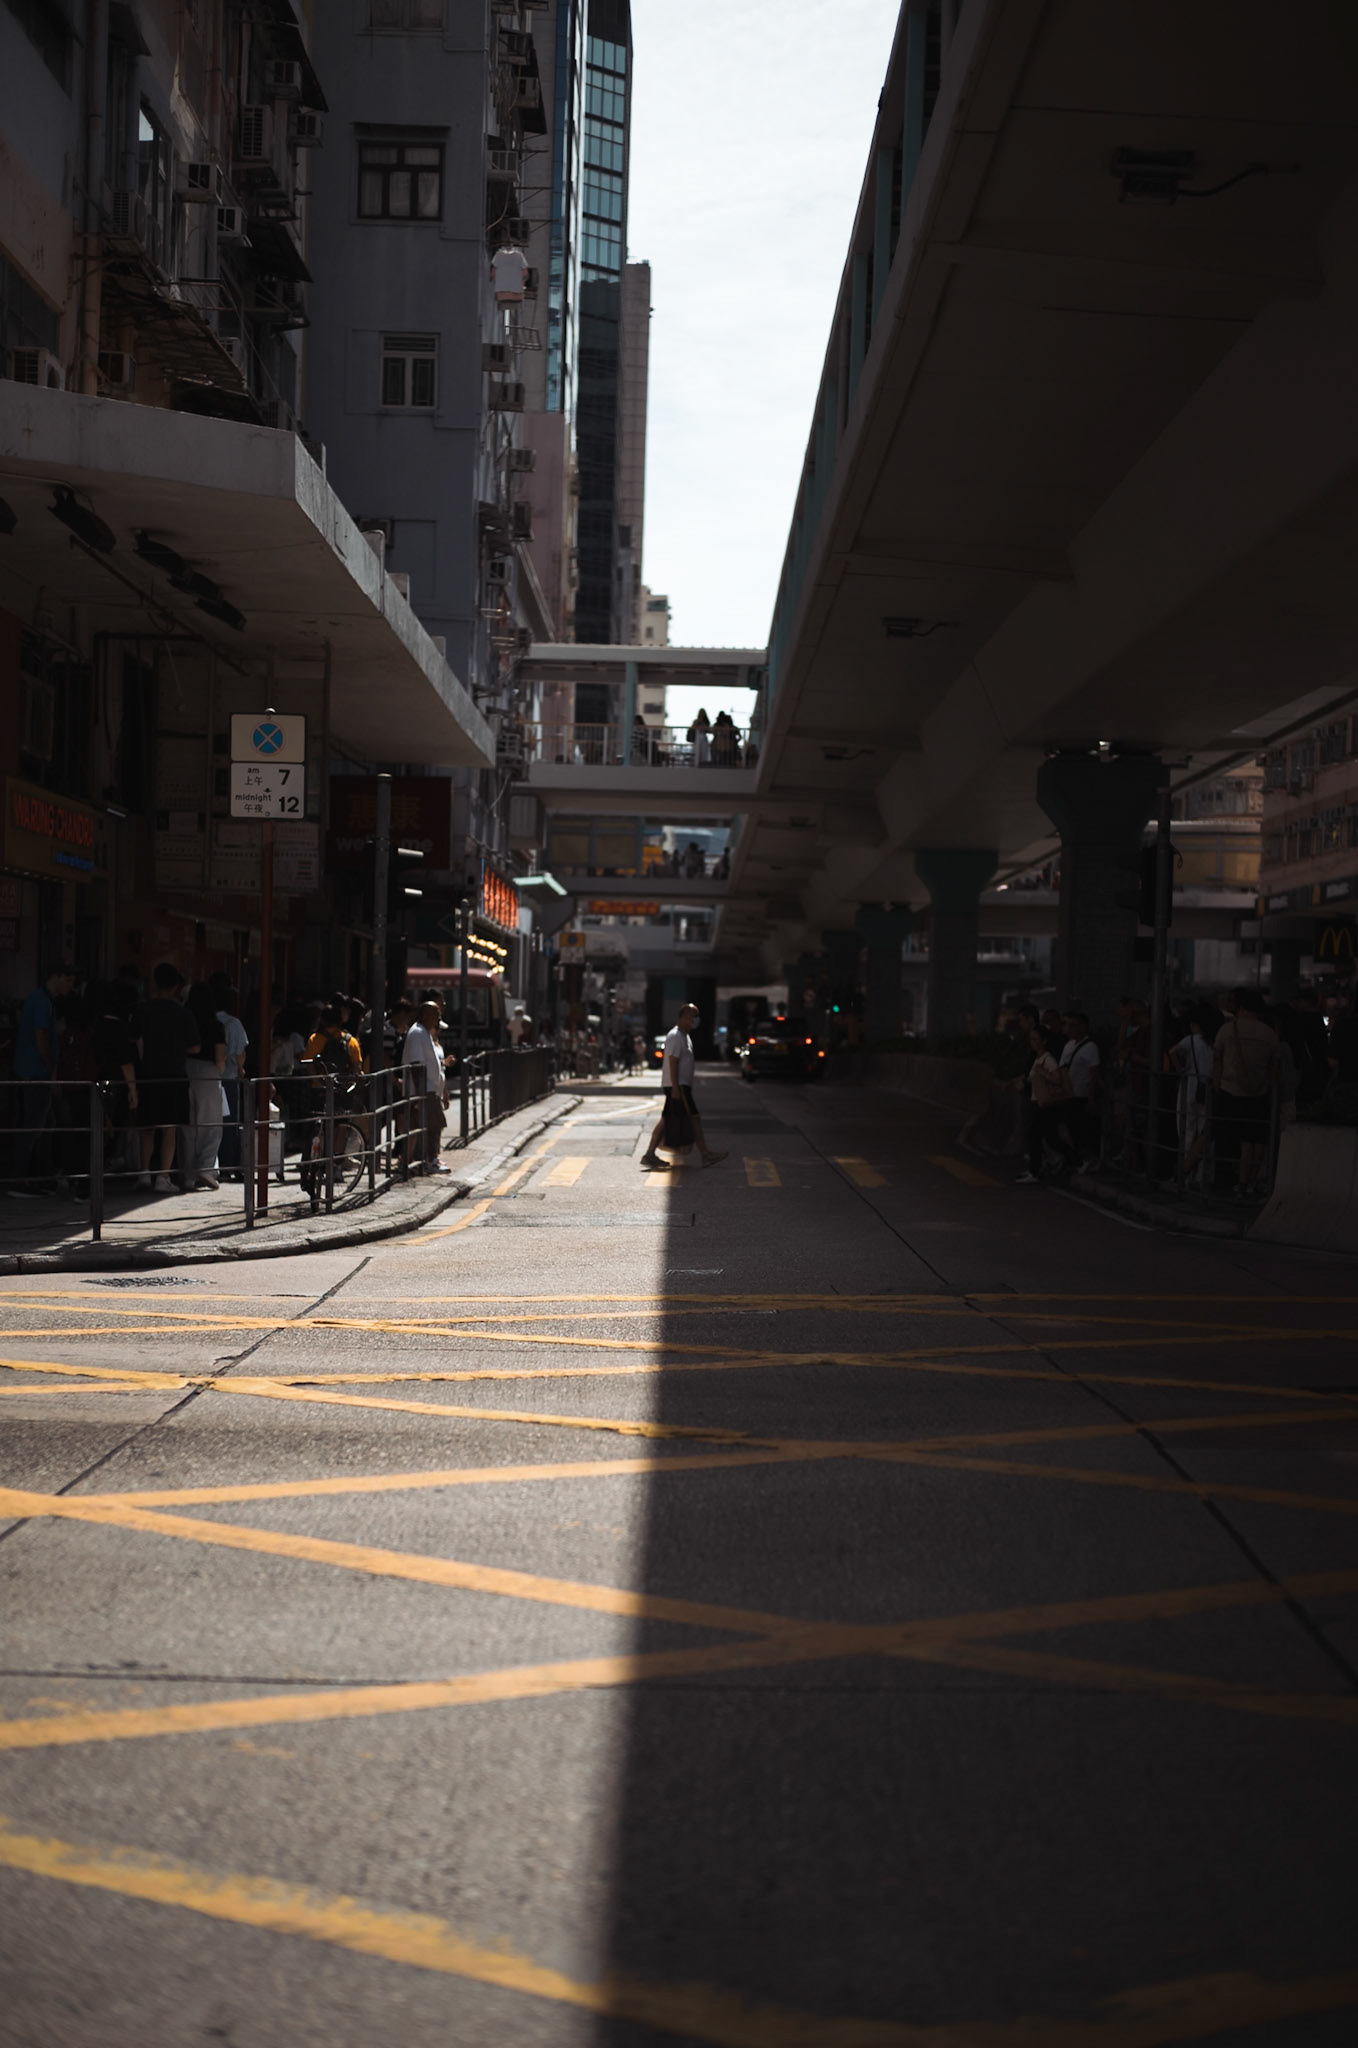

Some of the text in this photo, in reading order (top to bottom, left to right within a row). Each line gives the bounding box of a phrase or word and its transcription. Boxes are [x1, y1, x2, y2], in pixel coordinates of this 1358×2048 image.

[244, 776, 263, 785] 上午
[279, 769, 291, 785] 7
[235, 793, 299, 813] midnight 12
[244, 804, 264, 813] 午夜
